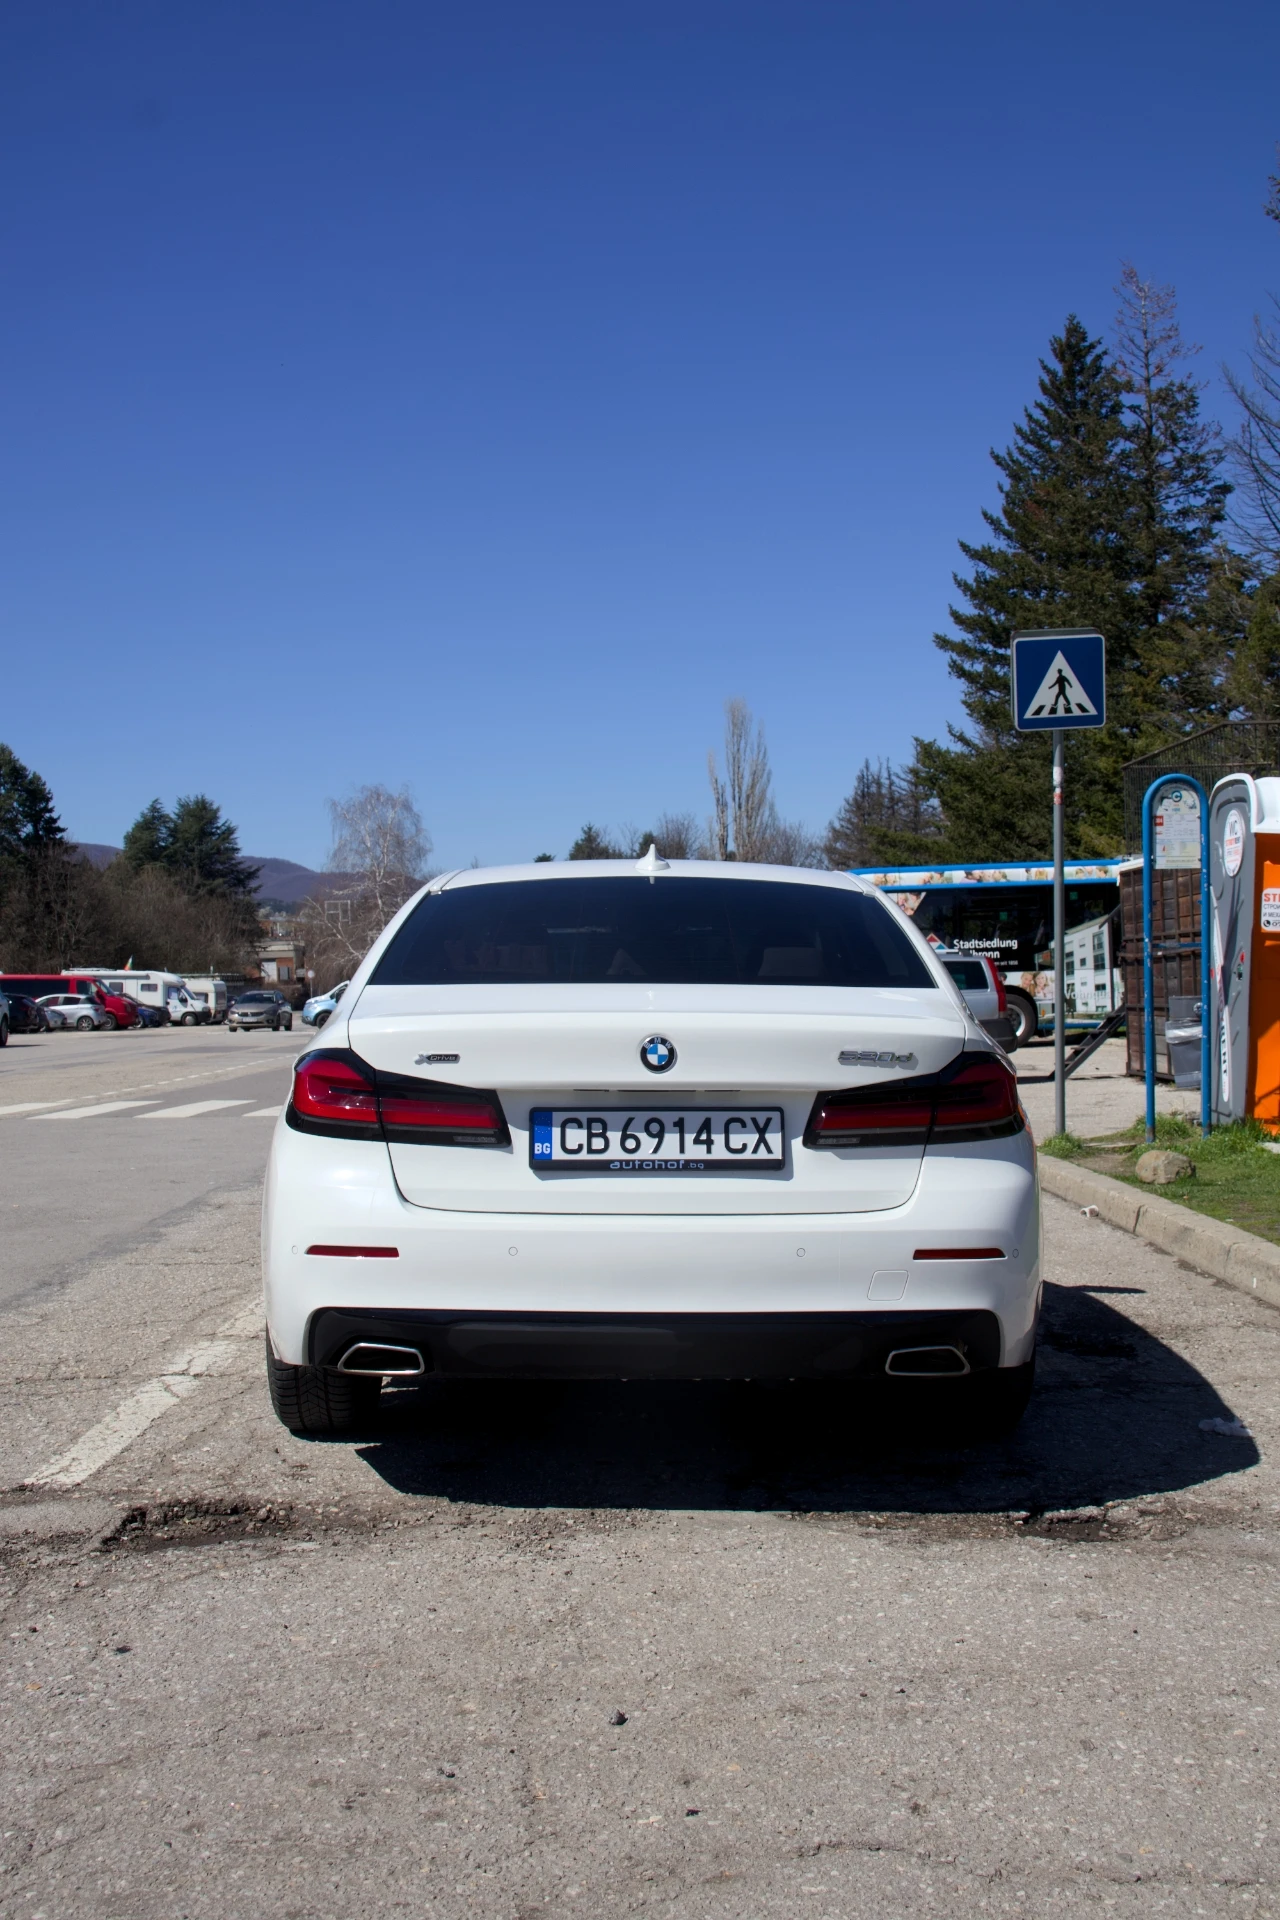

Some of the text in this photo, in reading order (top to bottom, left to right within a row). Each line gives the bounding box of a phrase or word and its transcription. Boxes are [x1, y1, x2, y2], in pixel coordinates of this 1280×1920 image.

[1263, 893, 1280, 902] ST
[953, 938, 1018, 949] Stadtsiedlung
[643, 1037, 674, 1049] BMW
[534, 1142, 551, 1155] BG
